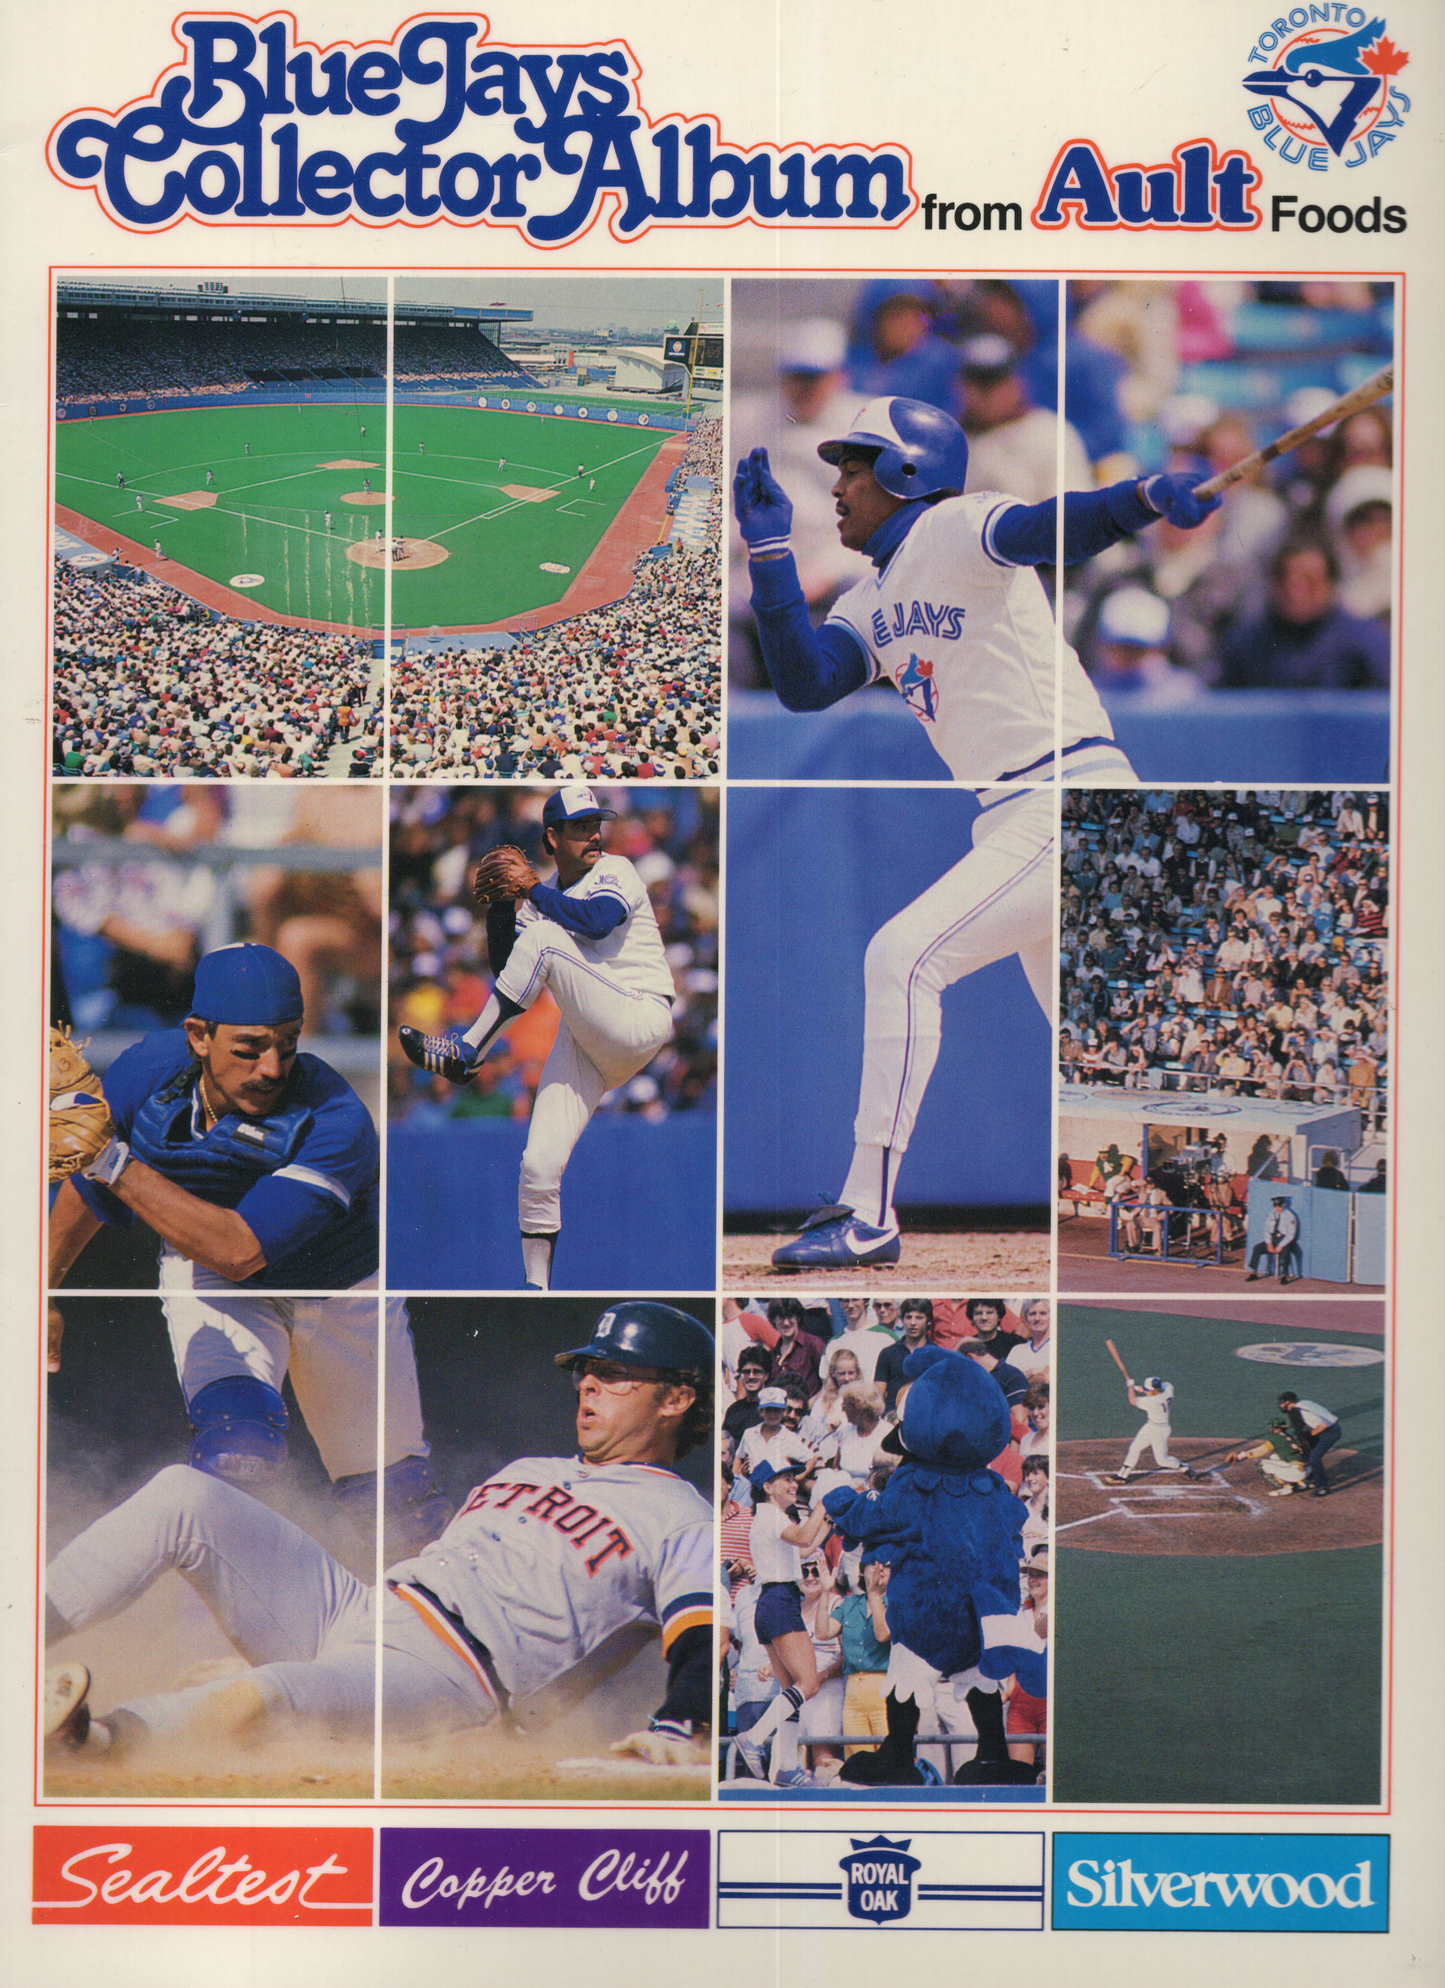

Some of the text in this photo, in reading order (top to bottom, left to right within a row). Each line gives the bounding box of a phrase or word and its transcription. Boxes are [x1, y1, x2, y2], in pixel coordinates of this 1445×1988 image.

[1247, 2, 1367, 64] TORONTO
[161, 21, 629, 146] Blue Jays
[1246, 85, 1412, 172] BLUE JAYS
[56, 106, 1408, 241] Collector Album from Ault Foods
[457, 1482, 635, 1580] ETROIT
[60, 1842, 349, 1910] Sealtest
[401, 1848, 690, 1911] Copper Cliff
[850, 1862, 910, 1885] ROYAL
[860, 1889, 899, 1912] OAK
[1066, 1857, 1376, 1909] Silverwood
